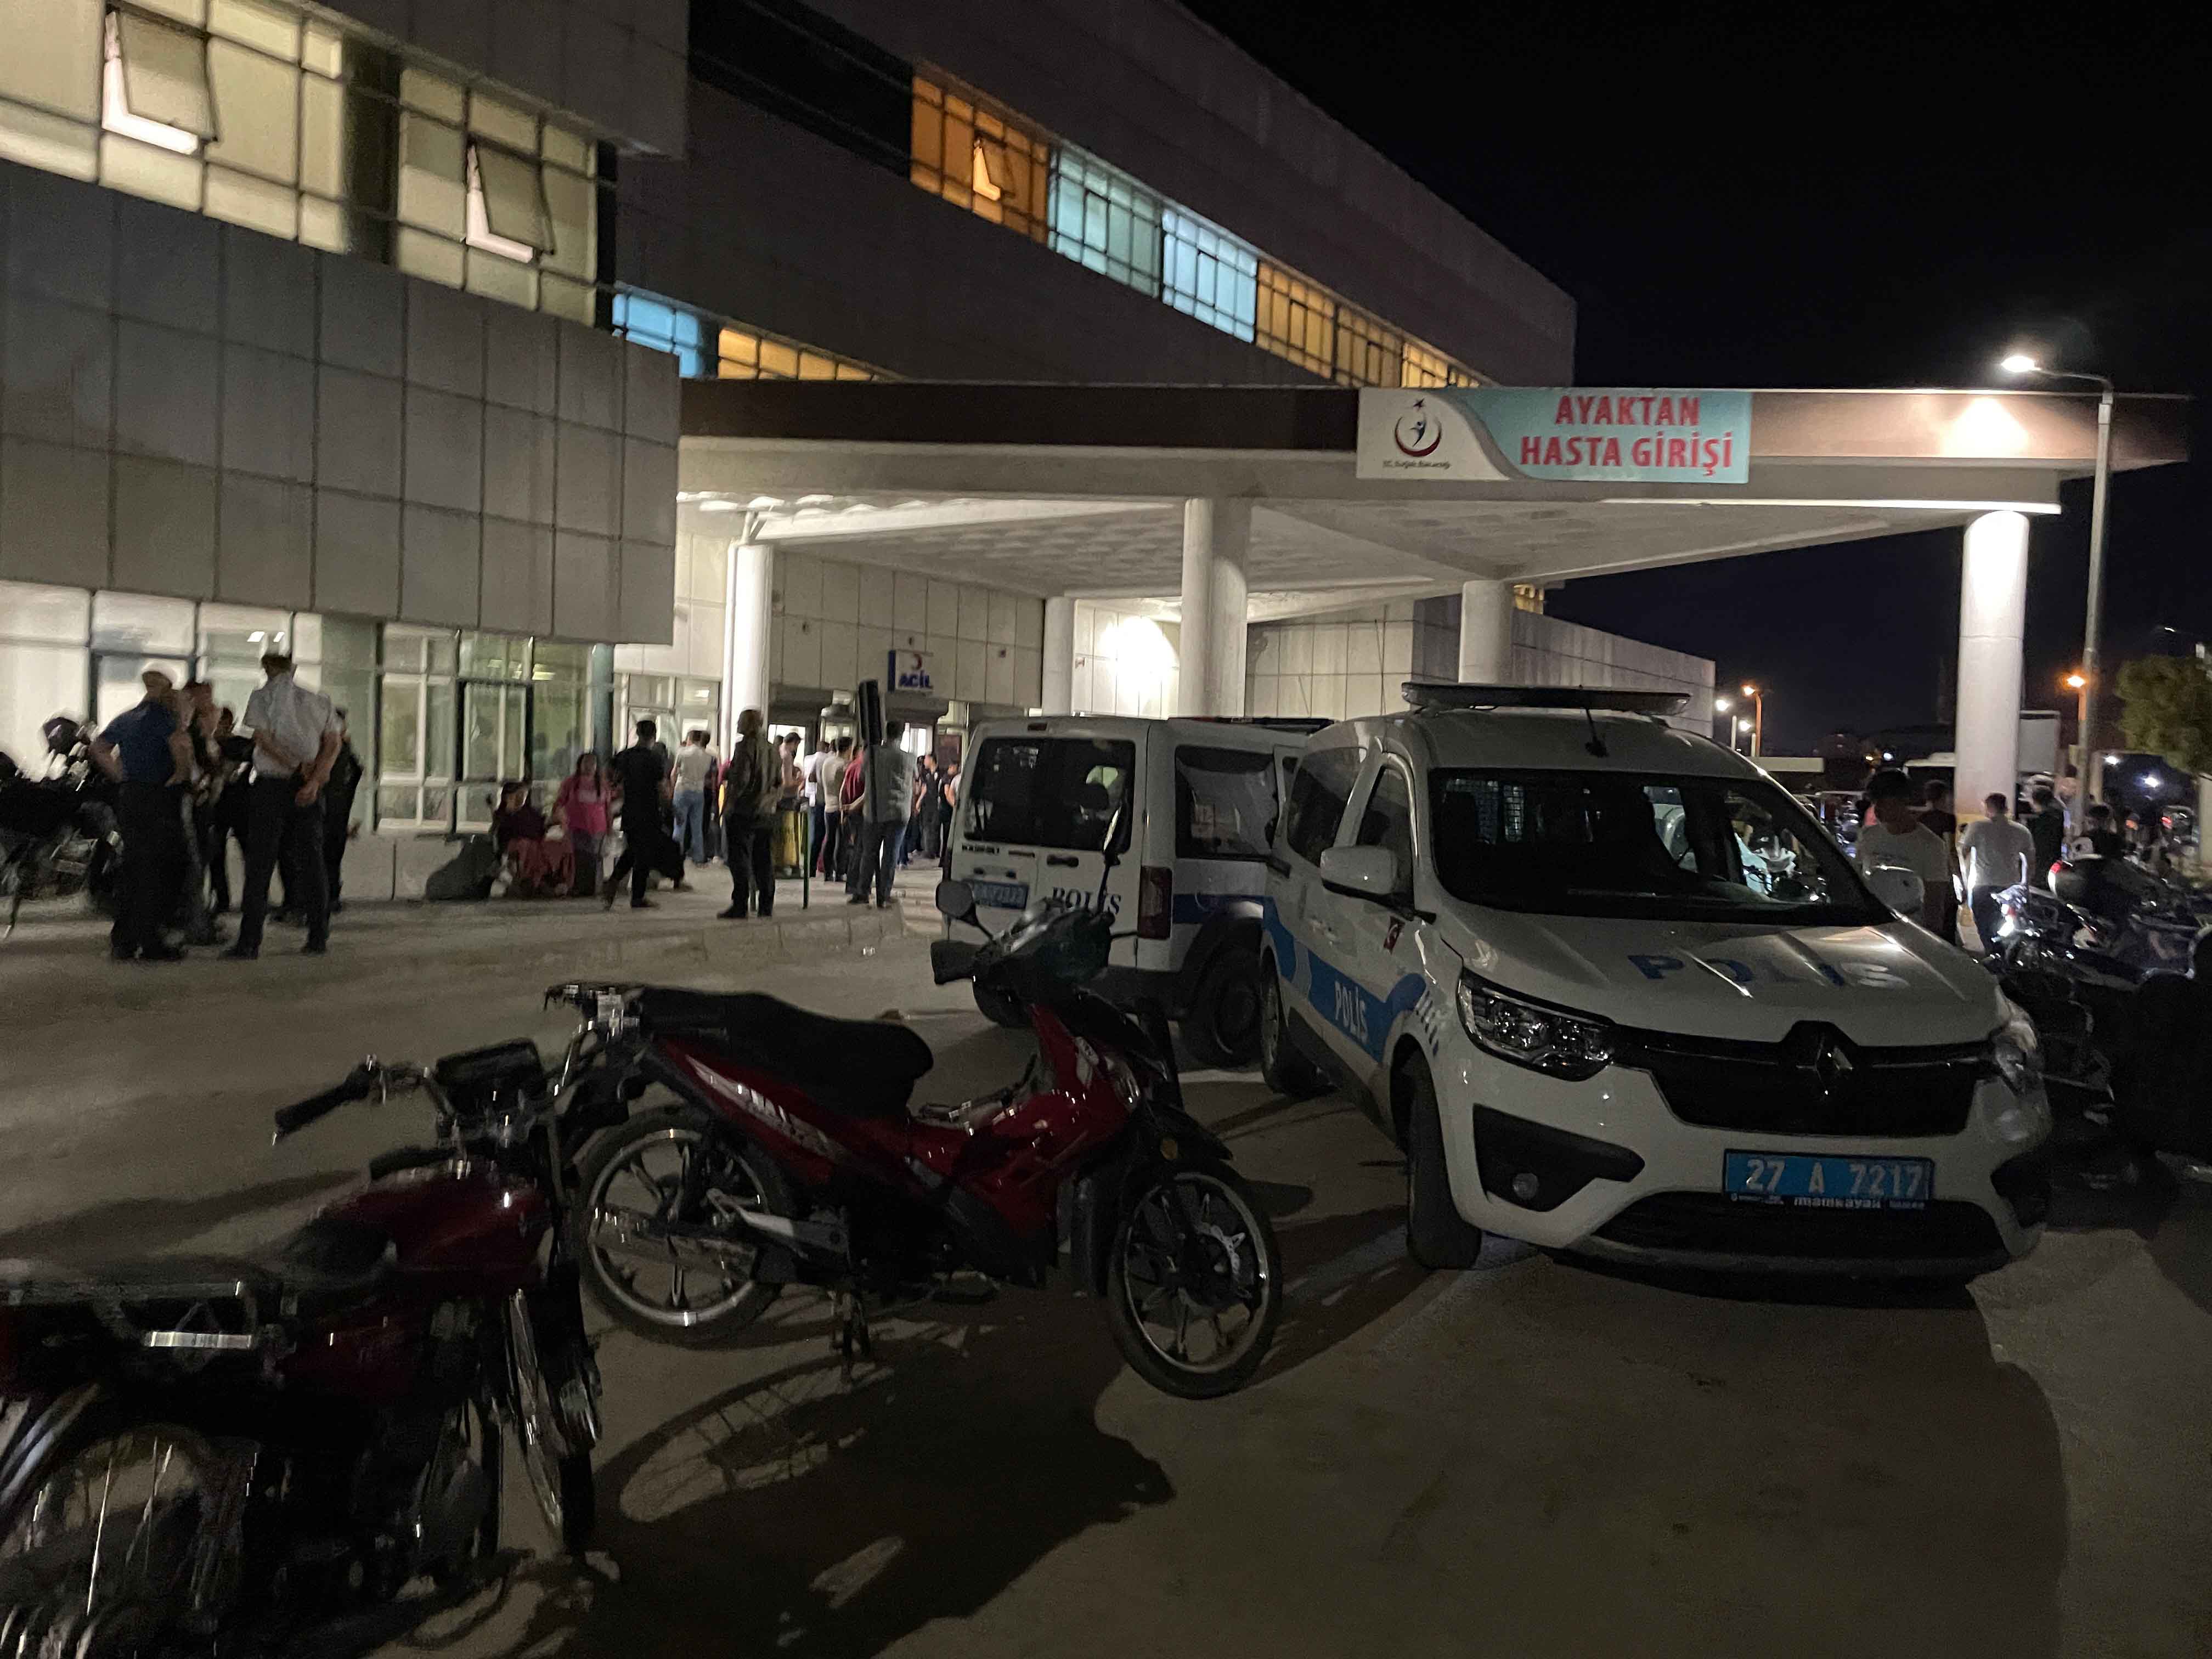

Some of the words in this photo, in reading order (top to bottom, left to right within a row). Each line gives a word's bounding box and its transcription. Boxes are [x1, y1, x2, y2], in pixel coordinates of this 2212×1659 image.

[1555, 395, 1699, 426] AYAKTAN
[1520, 436, 1622, 466] HASTA
[1632, 431, 1733, 477] GİRİŞİ
[1052, 887, 1122, 915] POLS
[1747, 1159, 1785, 1192] 27
[1808, 1161, 1825, 1194] A
[1849, 1163, 1922, 1197] 7217
